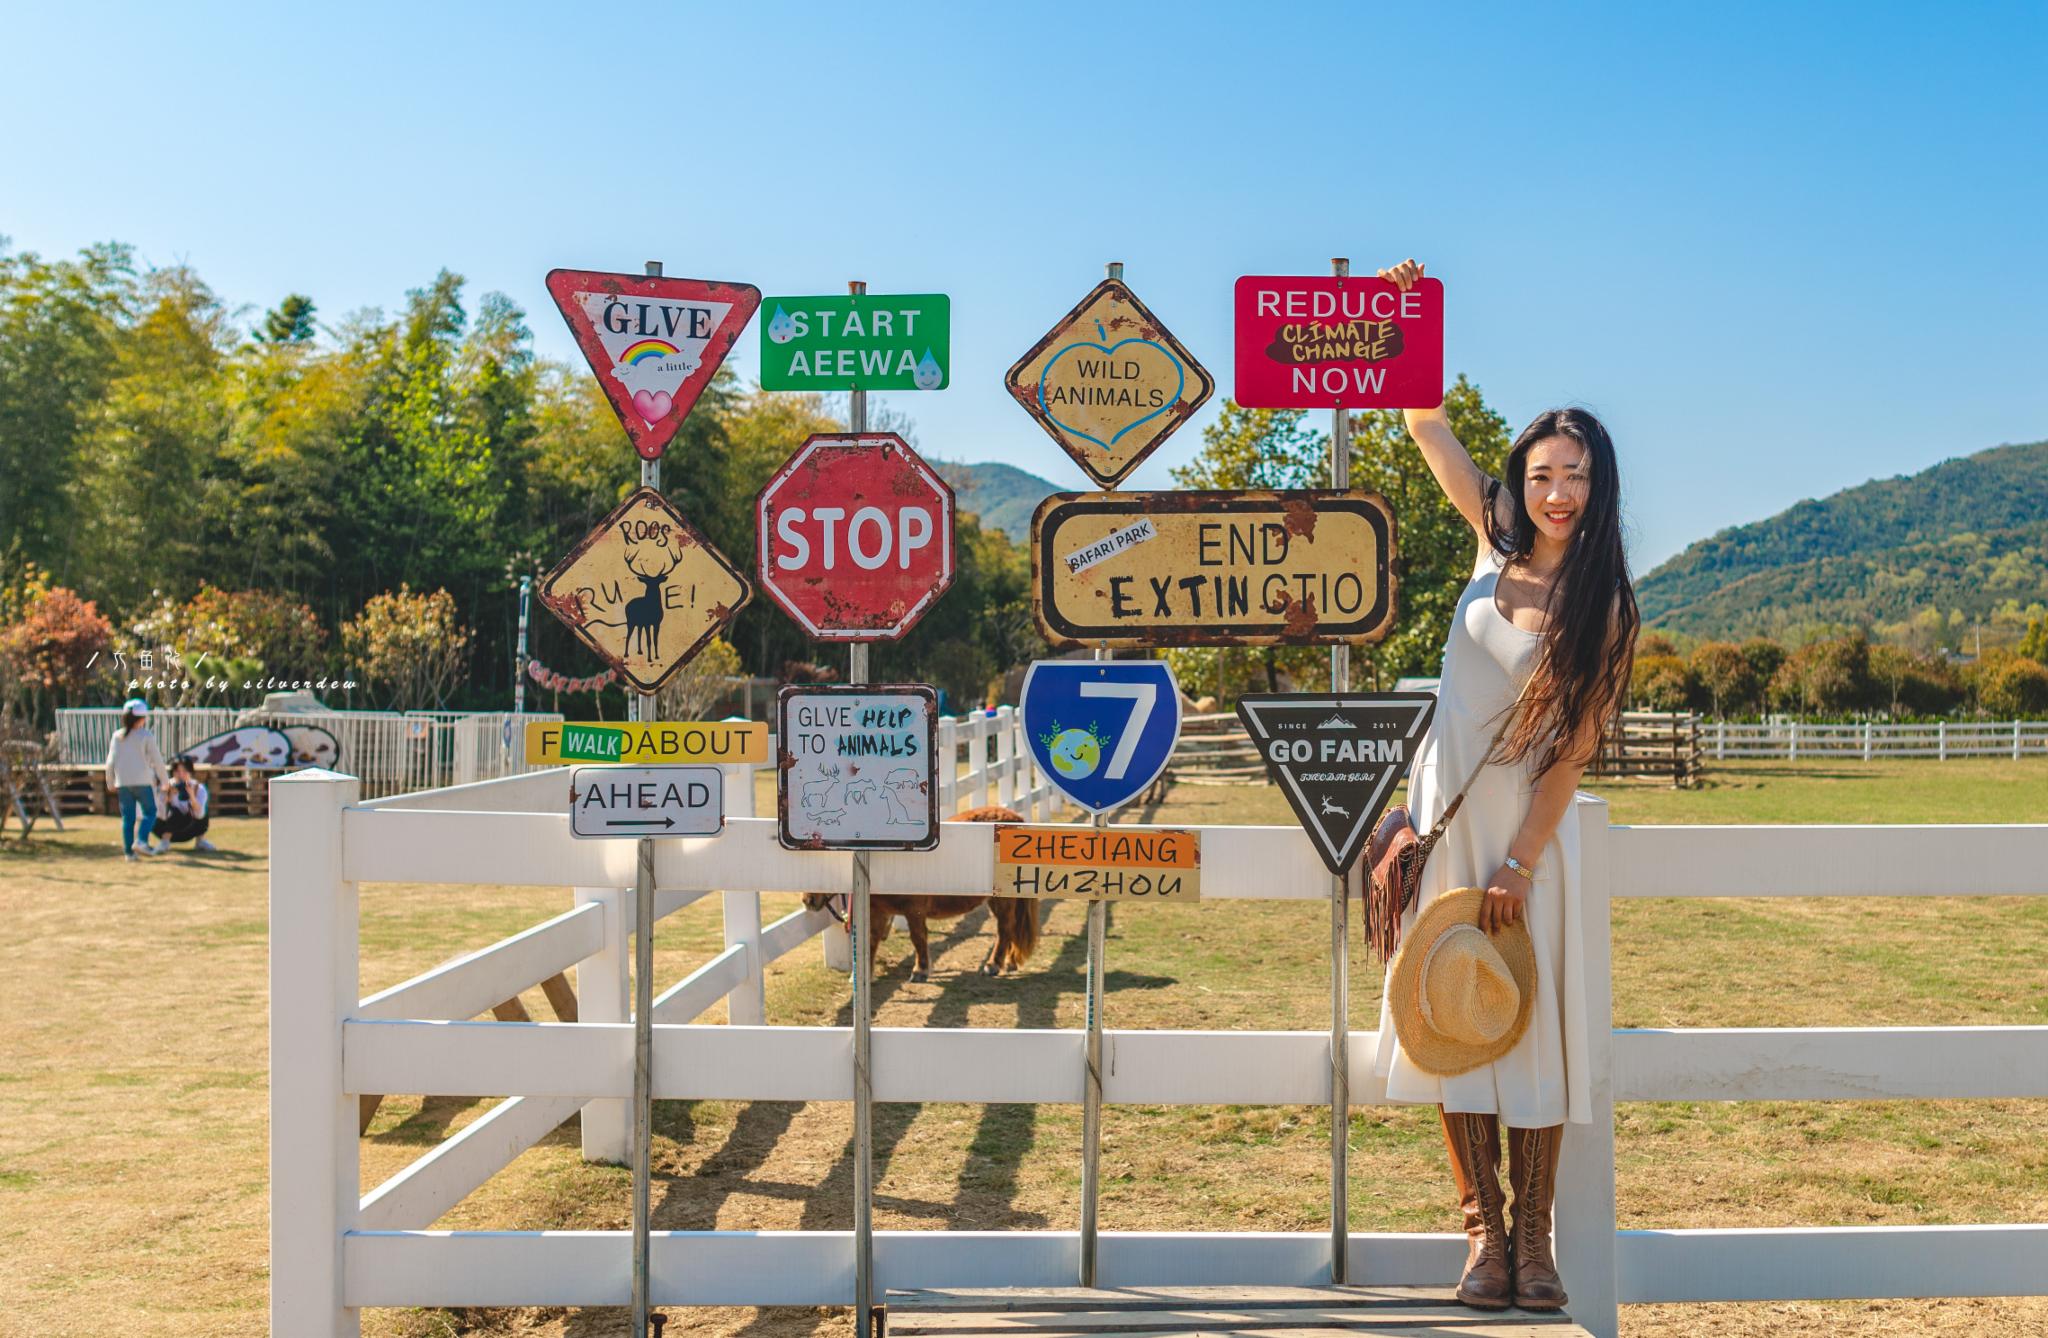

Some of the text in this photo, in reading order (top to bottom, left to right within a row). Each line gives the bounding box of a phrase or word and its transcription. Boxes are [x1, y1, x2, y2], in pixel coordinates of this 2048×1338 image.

[1258, 291, 1422, 319] REDUCE
[603, 302, 712, 339] GLVE
[789, 310, 921, 338] START
[1282, 319, 1396, 343] CLIMATE
[788, 349, 919, 376] AEEWA
[1292, 340, 1389, 362] CHANGE
[666, 361, 693, 371] little
[1077, 360, 1140, 380] WILD
[1292, 367, 1387, 394] NOW
[1052, 386, 1164, 408] ANIMALS
[619, 519, 671, 548] ROOS
[777, 506, 934, 571] STOP
[1070, 523, 1151, 570] SAFARI PARK
[1199, 523, 1289, 567] END
[799, 706, 912, 728] GLVE HELP
[567, 731, 618, 756] WALK
[1080, 682, 1156, 780] 7
[798, 733, 918, 757] TO ANIMALS
[1269, 739, 1403, 763] GO FARM
[581, 783, 711, 809] AHEAD
[1012, 835, 1178, 864] ZHEJIANG
[1013, 866, 1182, 896] HUZHOU
